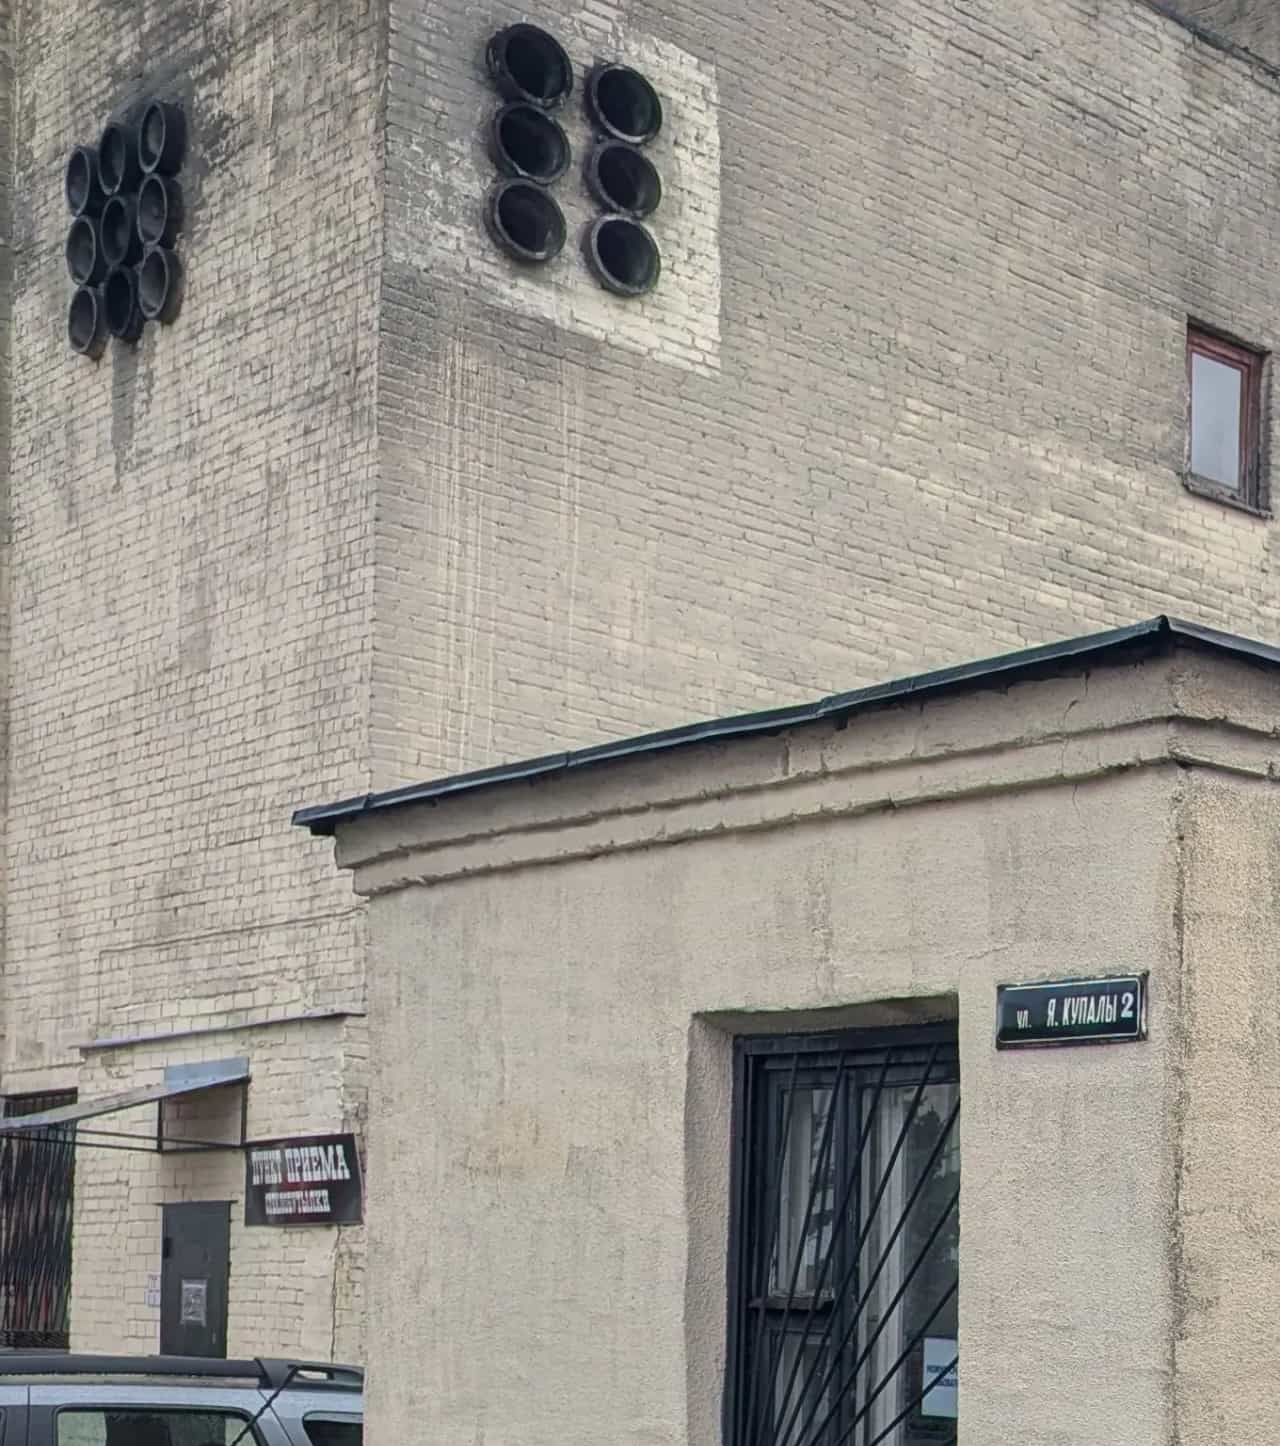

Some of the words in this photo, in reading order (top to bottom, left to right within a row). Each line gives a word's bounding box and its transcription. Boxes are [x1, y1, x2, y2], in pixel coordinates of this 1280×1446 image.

[1046, 999, 1059, 1027] Я.
[1062, 995, 1117, 1026] КУПАЛЫ
[1120, 991, 1134, 1018] 2
[285, 1144, 350, 1182] ПРИЕМА
